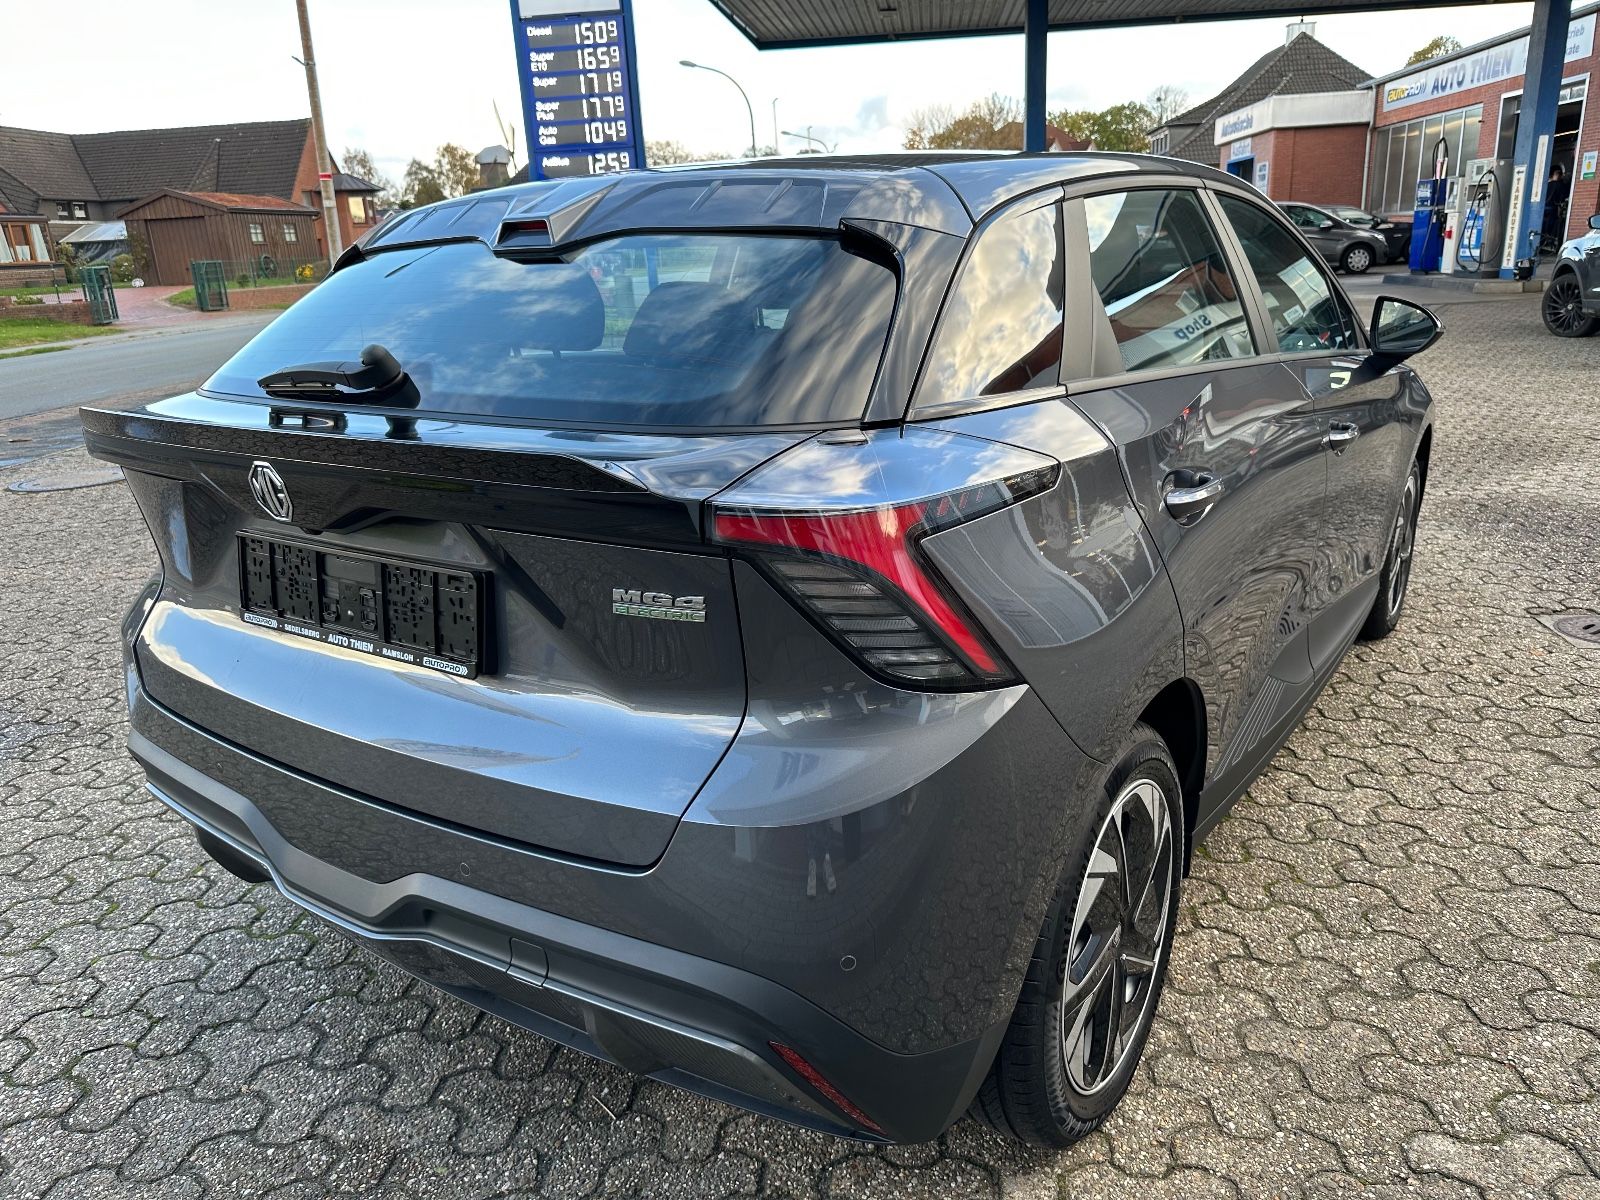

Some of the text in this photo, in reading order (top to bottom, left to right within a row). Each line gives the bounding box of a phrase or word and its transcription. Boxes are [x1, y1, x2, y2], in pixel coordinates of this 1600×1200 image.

[526, 20, 617, 45] Diesel 1509
[529, 45, 620, 70] Super 1659
[530, 61, 548, 72] E10
[532, 71, 622, 94] Super 1719
[1431, 62, 1466, 95] AUTO
[1470, 49, 1514, 84] THIEN
[535, 95, 625, 119] Super 1779
[536, 111, 555, 121] Plus
[538, 120, 627, 144] Auto 1049
[539, 136, 557, 145] Gas
[587, 151, 630, 175] 1259
[1504, 177, 1522, 265] TANKAUTOMAT
[250, 462, 292, 521] MG
[612, 588, 706, 610] MG4
[614, 604, 703, 622] ELECTRIC
[284, 623, 320, 639] SEDELSBERG
[327, 633, 348, 647] AUTO
[349, 638, 374, 653] THIEN
[382, 648, 414, 661] RAMSLOH
